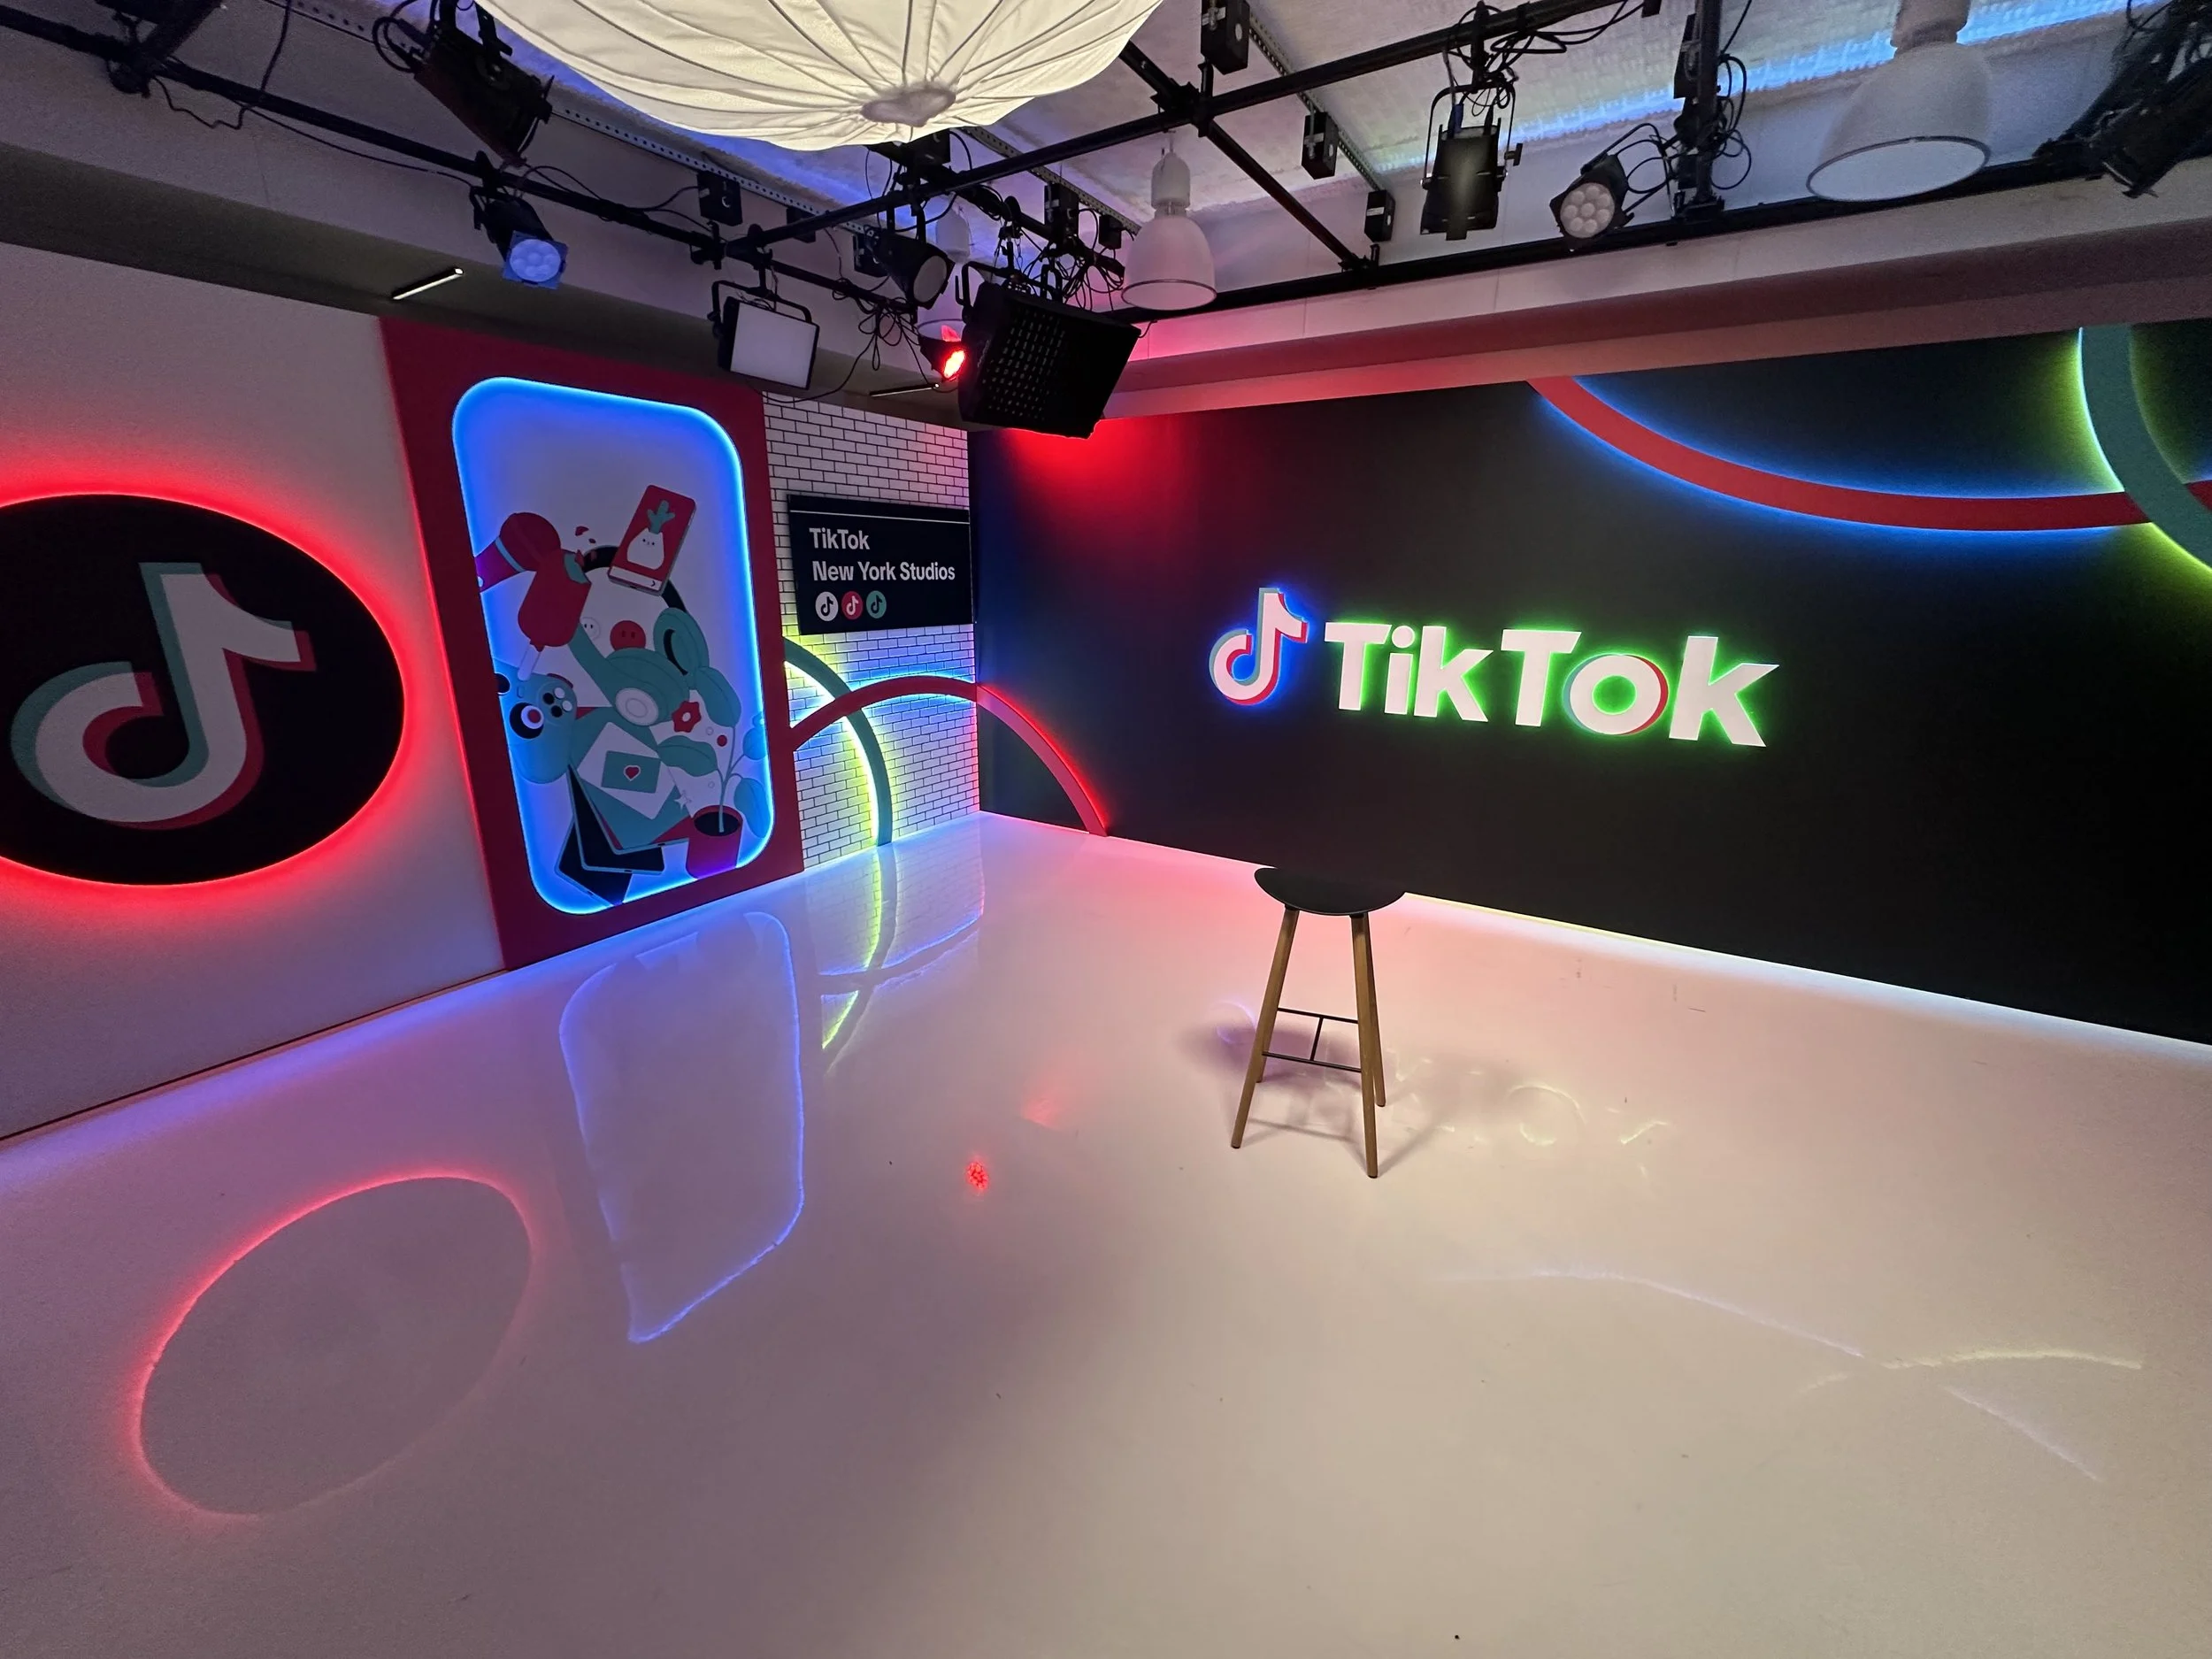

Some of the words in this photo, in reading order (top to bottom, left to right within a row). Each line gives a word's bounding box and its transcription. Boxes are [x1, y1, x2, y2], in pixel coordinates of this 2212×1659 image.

[809, 527, 870, 549] TikTok
[812, 560, 854, 581] New
[857, 561, 896, 580] York
[900, 562, 956, 580] Studios
[1324, 621, 1779, 747] TikTok
